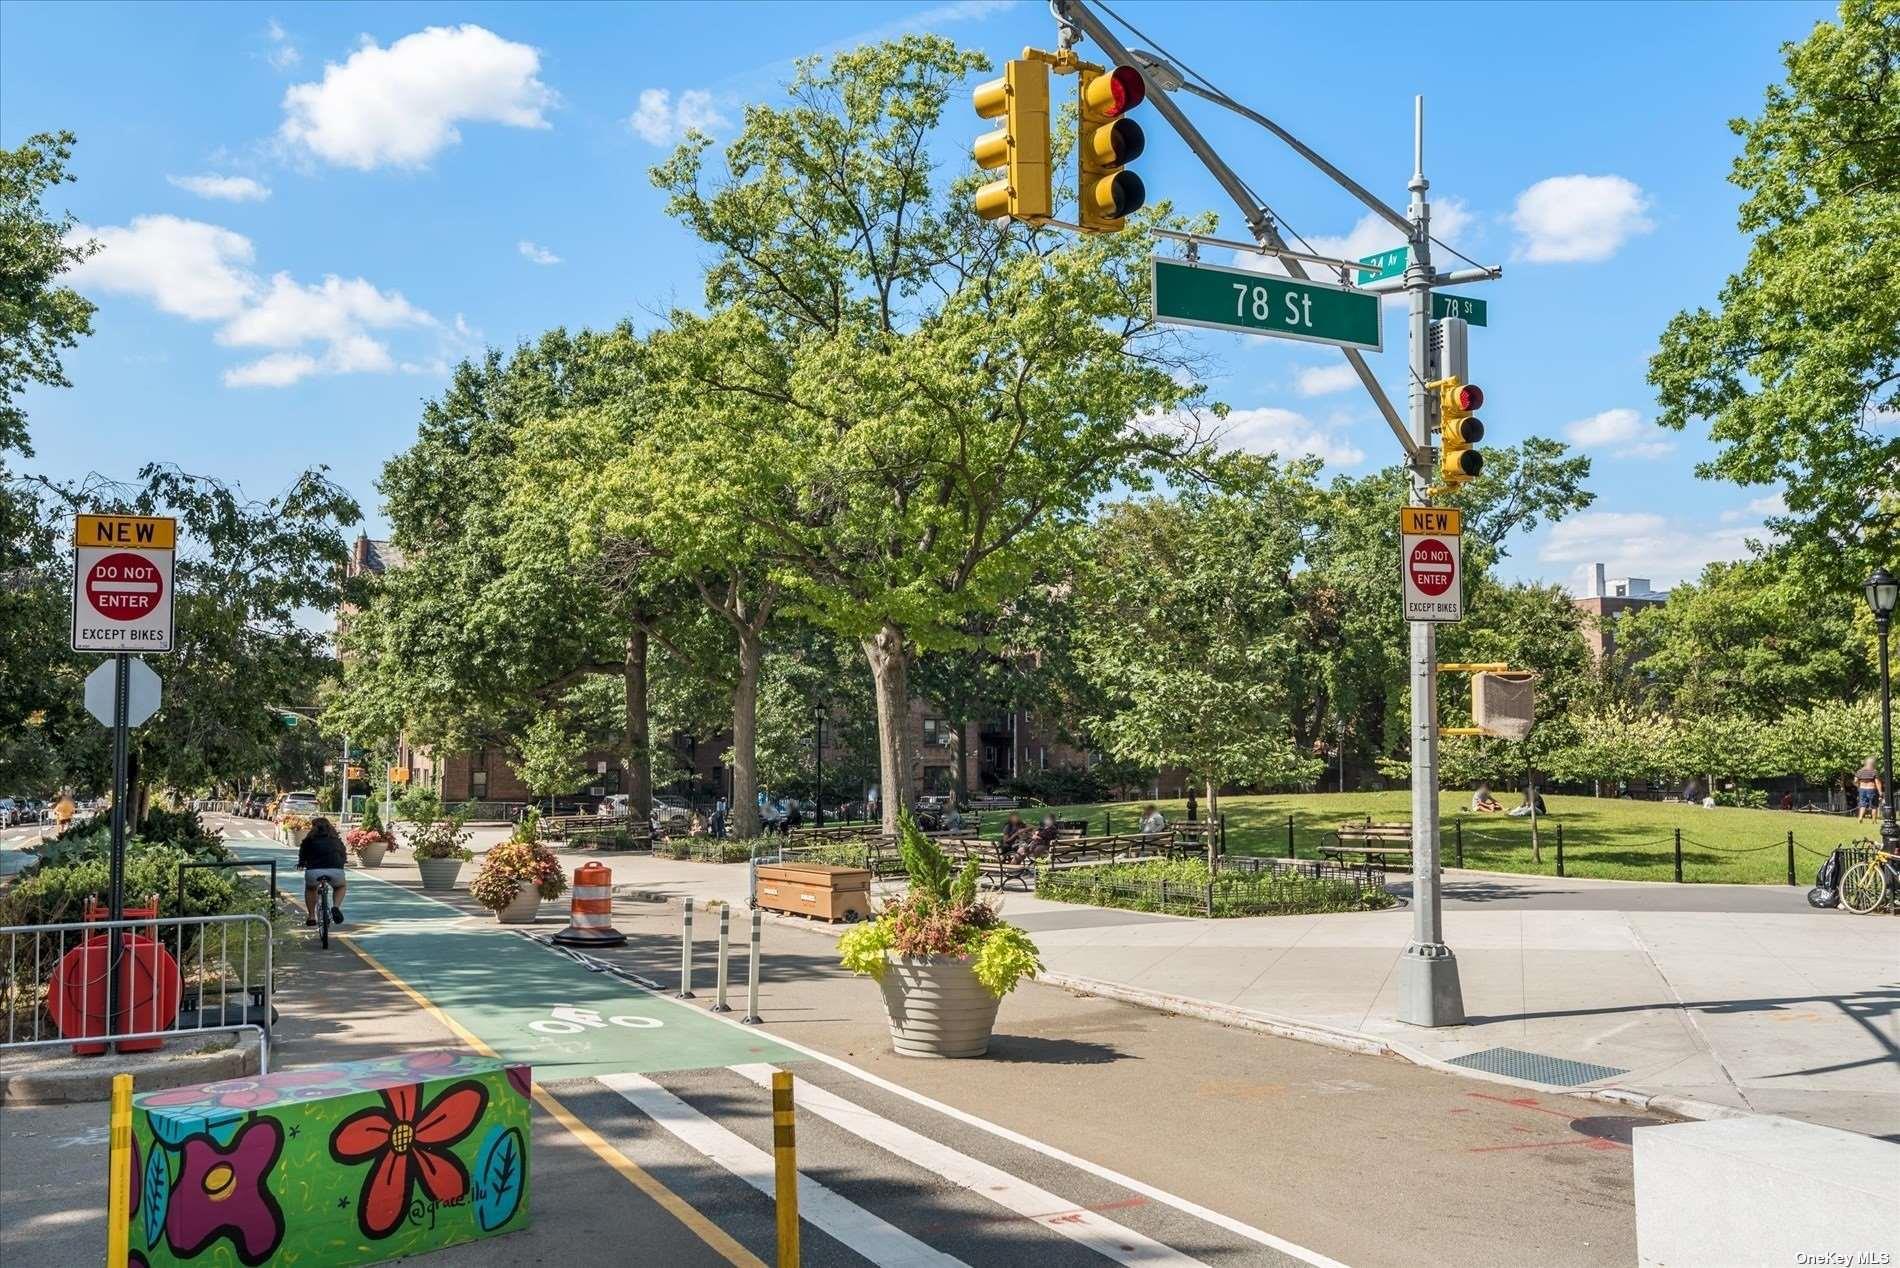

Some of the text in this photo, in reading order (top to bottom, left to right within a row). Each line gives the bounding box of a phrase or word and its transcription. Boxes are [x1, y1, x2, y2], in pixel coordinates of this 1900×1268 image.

[1388, 253, 1398, 266] Av
[1233, 283, 1313, 328] 78 St
[1444, 298, 1473, 319] 78 St
[1414, 513, 1447, 530] NEW
[98, 522, 154, 542] NEW
[1415, 551, 1448, 561] DO NOT
[96, 566, 154, 580] DO NOT
[1418, 574, 1447, 585] ENTER
[99, 594, 149, 608] ENTER
[1409, 603, 1457, 613] EXCEPT BIKES
[82, 628, 164, 642] EXCEPT BIKES
